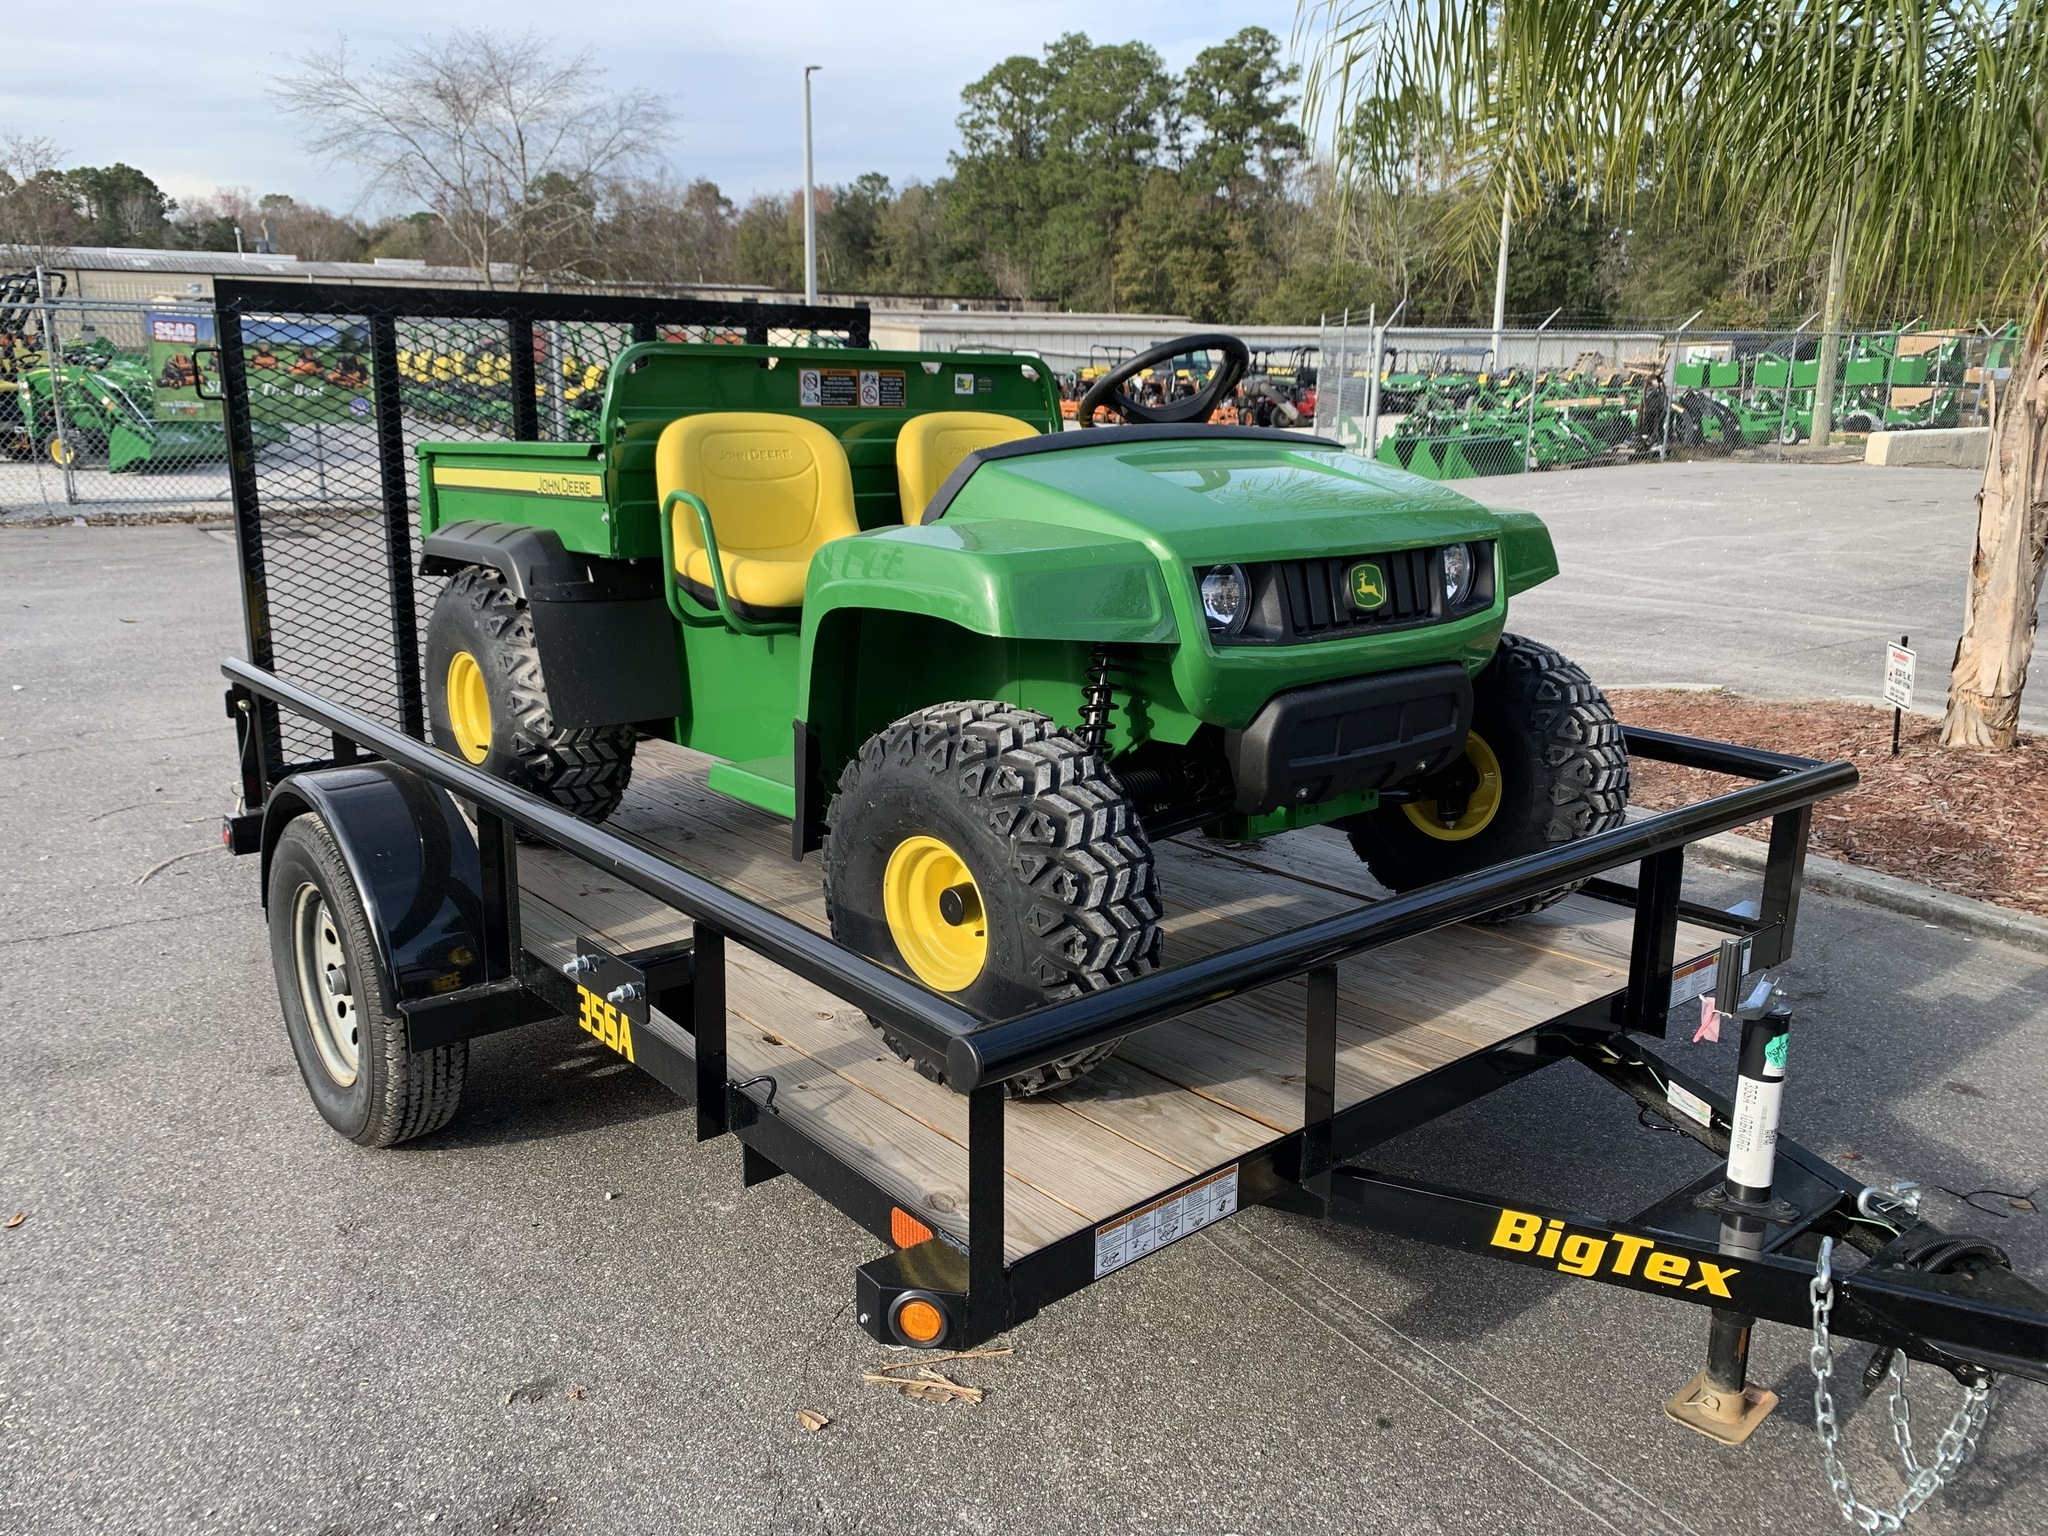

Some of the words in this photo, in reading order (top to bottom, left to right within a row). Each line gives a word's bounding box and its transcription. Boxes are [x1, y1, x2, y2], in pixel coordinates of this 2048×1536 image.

[154, 321, 196, 336] SCAG
[720, 449, 749, 461] JOHN
[749, 448, 793, 460] DEERE
[538, 476, 560, 494] JOHN
[561, 477, 592, 496] DEERE
[1490, 1208, 1741, 1299] BigTex
